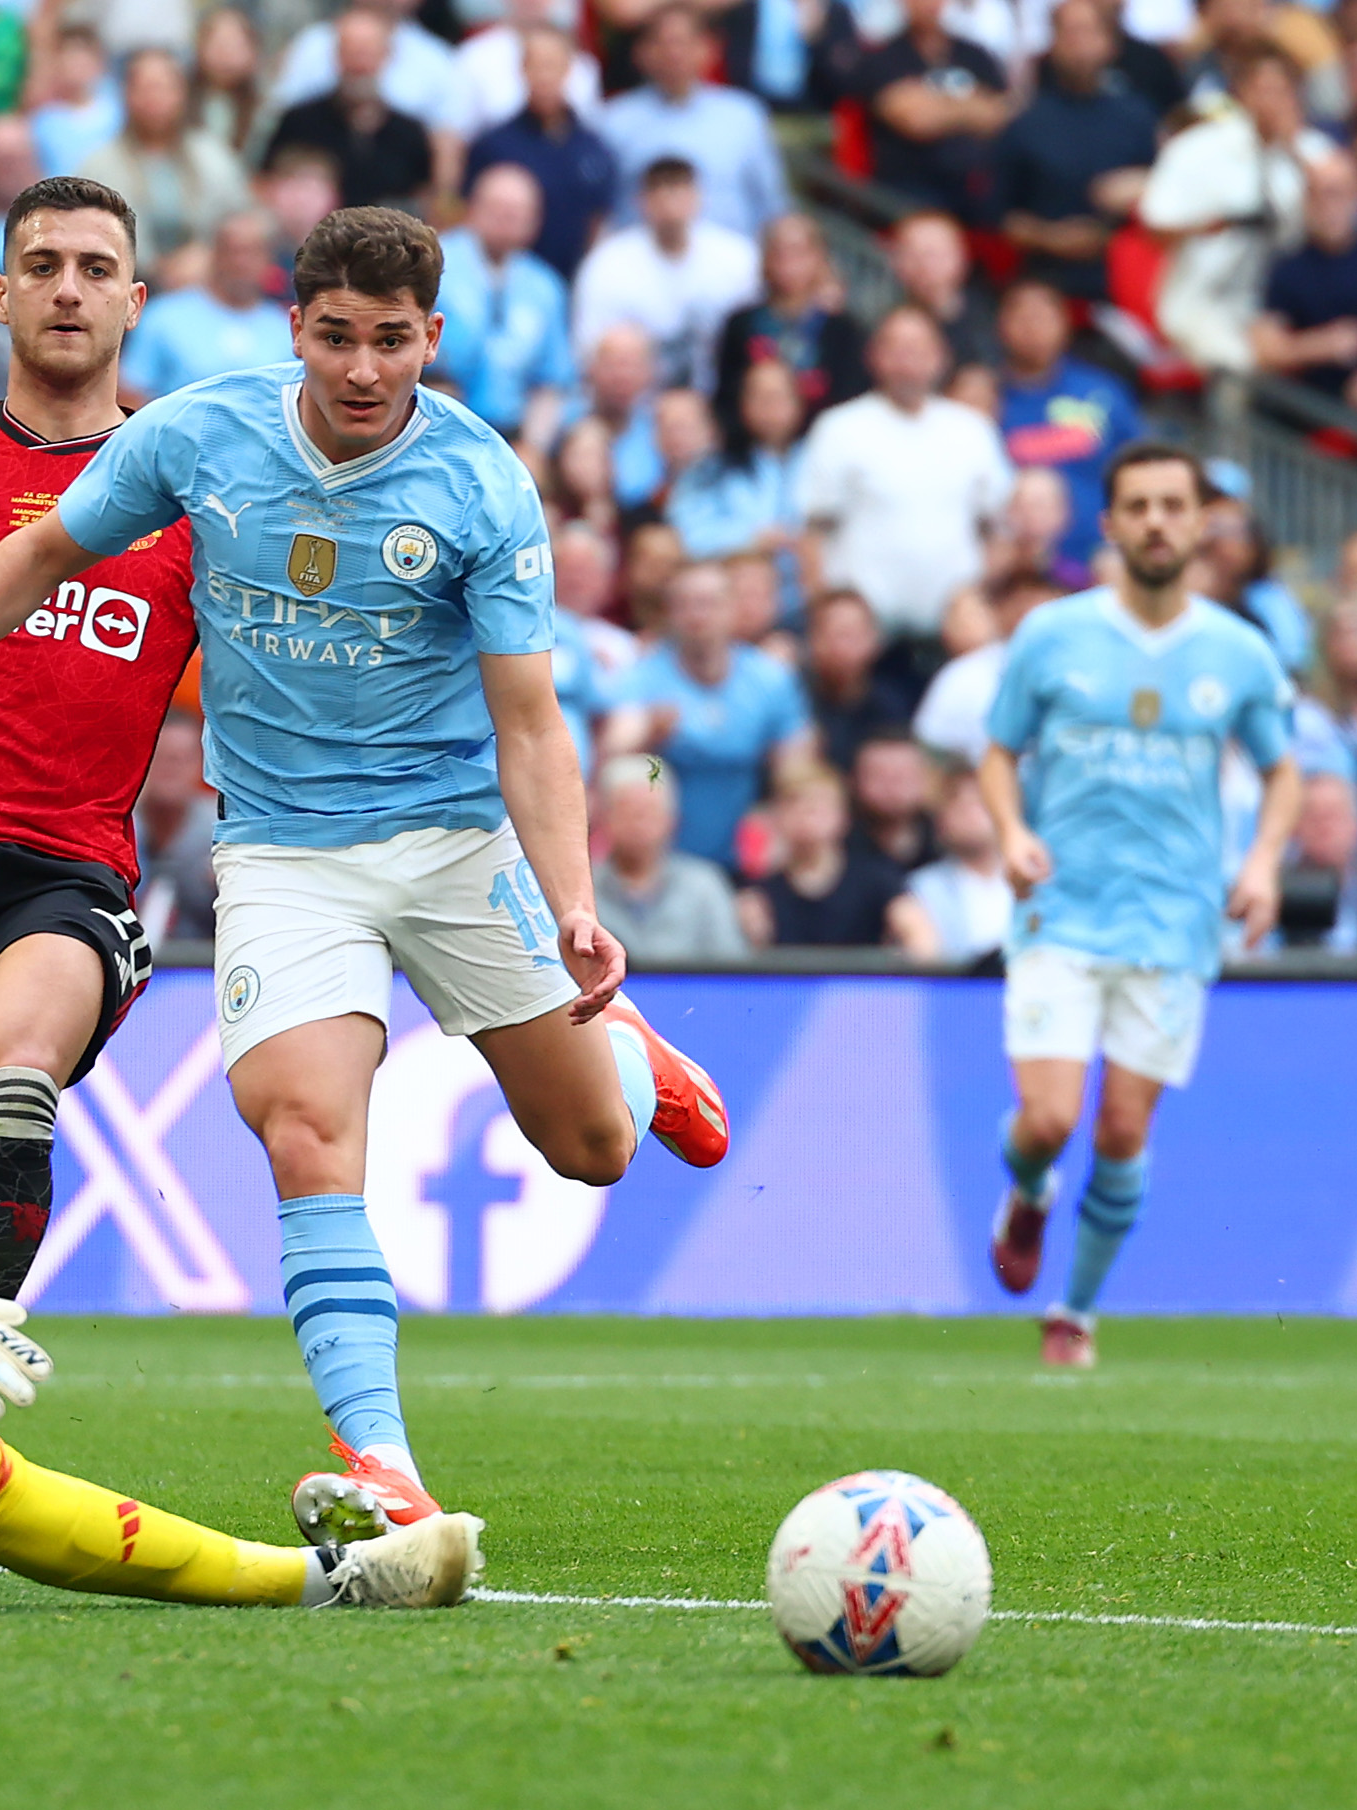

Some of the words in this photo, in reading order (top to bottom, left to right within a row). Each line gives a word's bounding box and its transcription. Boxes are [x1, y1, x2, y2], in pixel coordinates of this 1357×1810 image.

[10, 496, 58, 507] MANCHESTER
[12, 507, 46, 517] MANCHES
[389, 527, 434, 550] MANCHESTER
[299, 572, 321, 585] FIFA
[397, 570, 414, 578] CITY
[229, 623, 385, 666] AIRWAYS
[487, 858, 560, 951] 19
